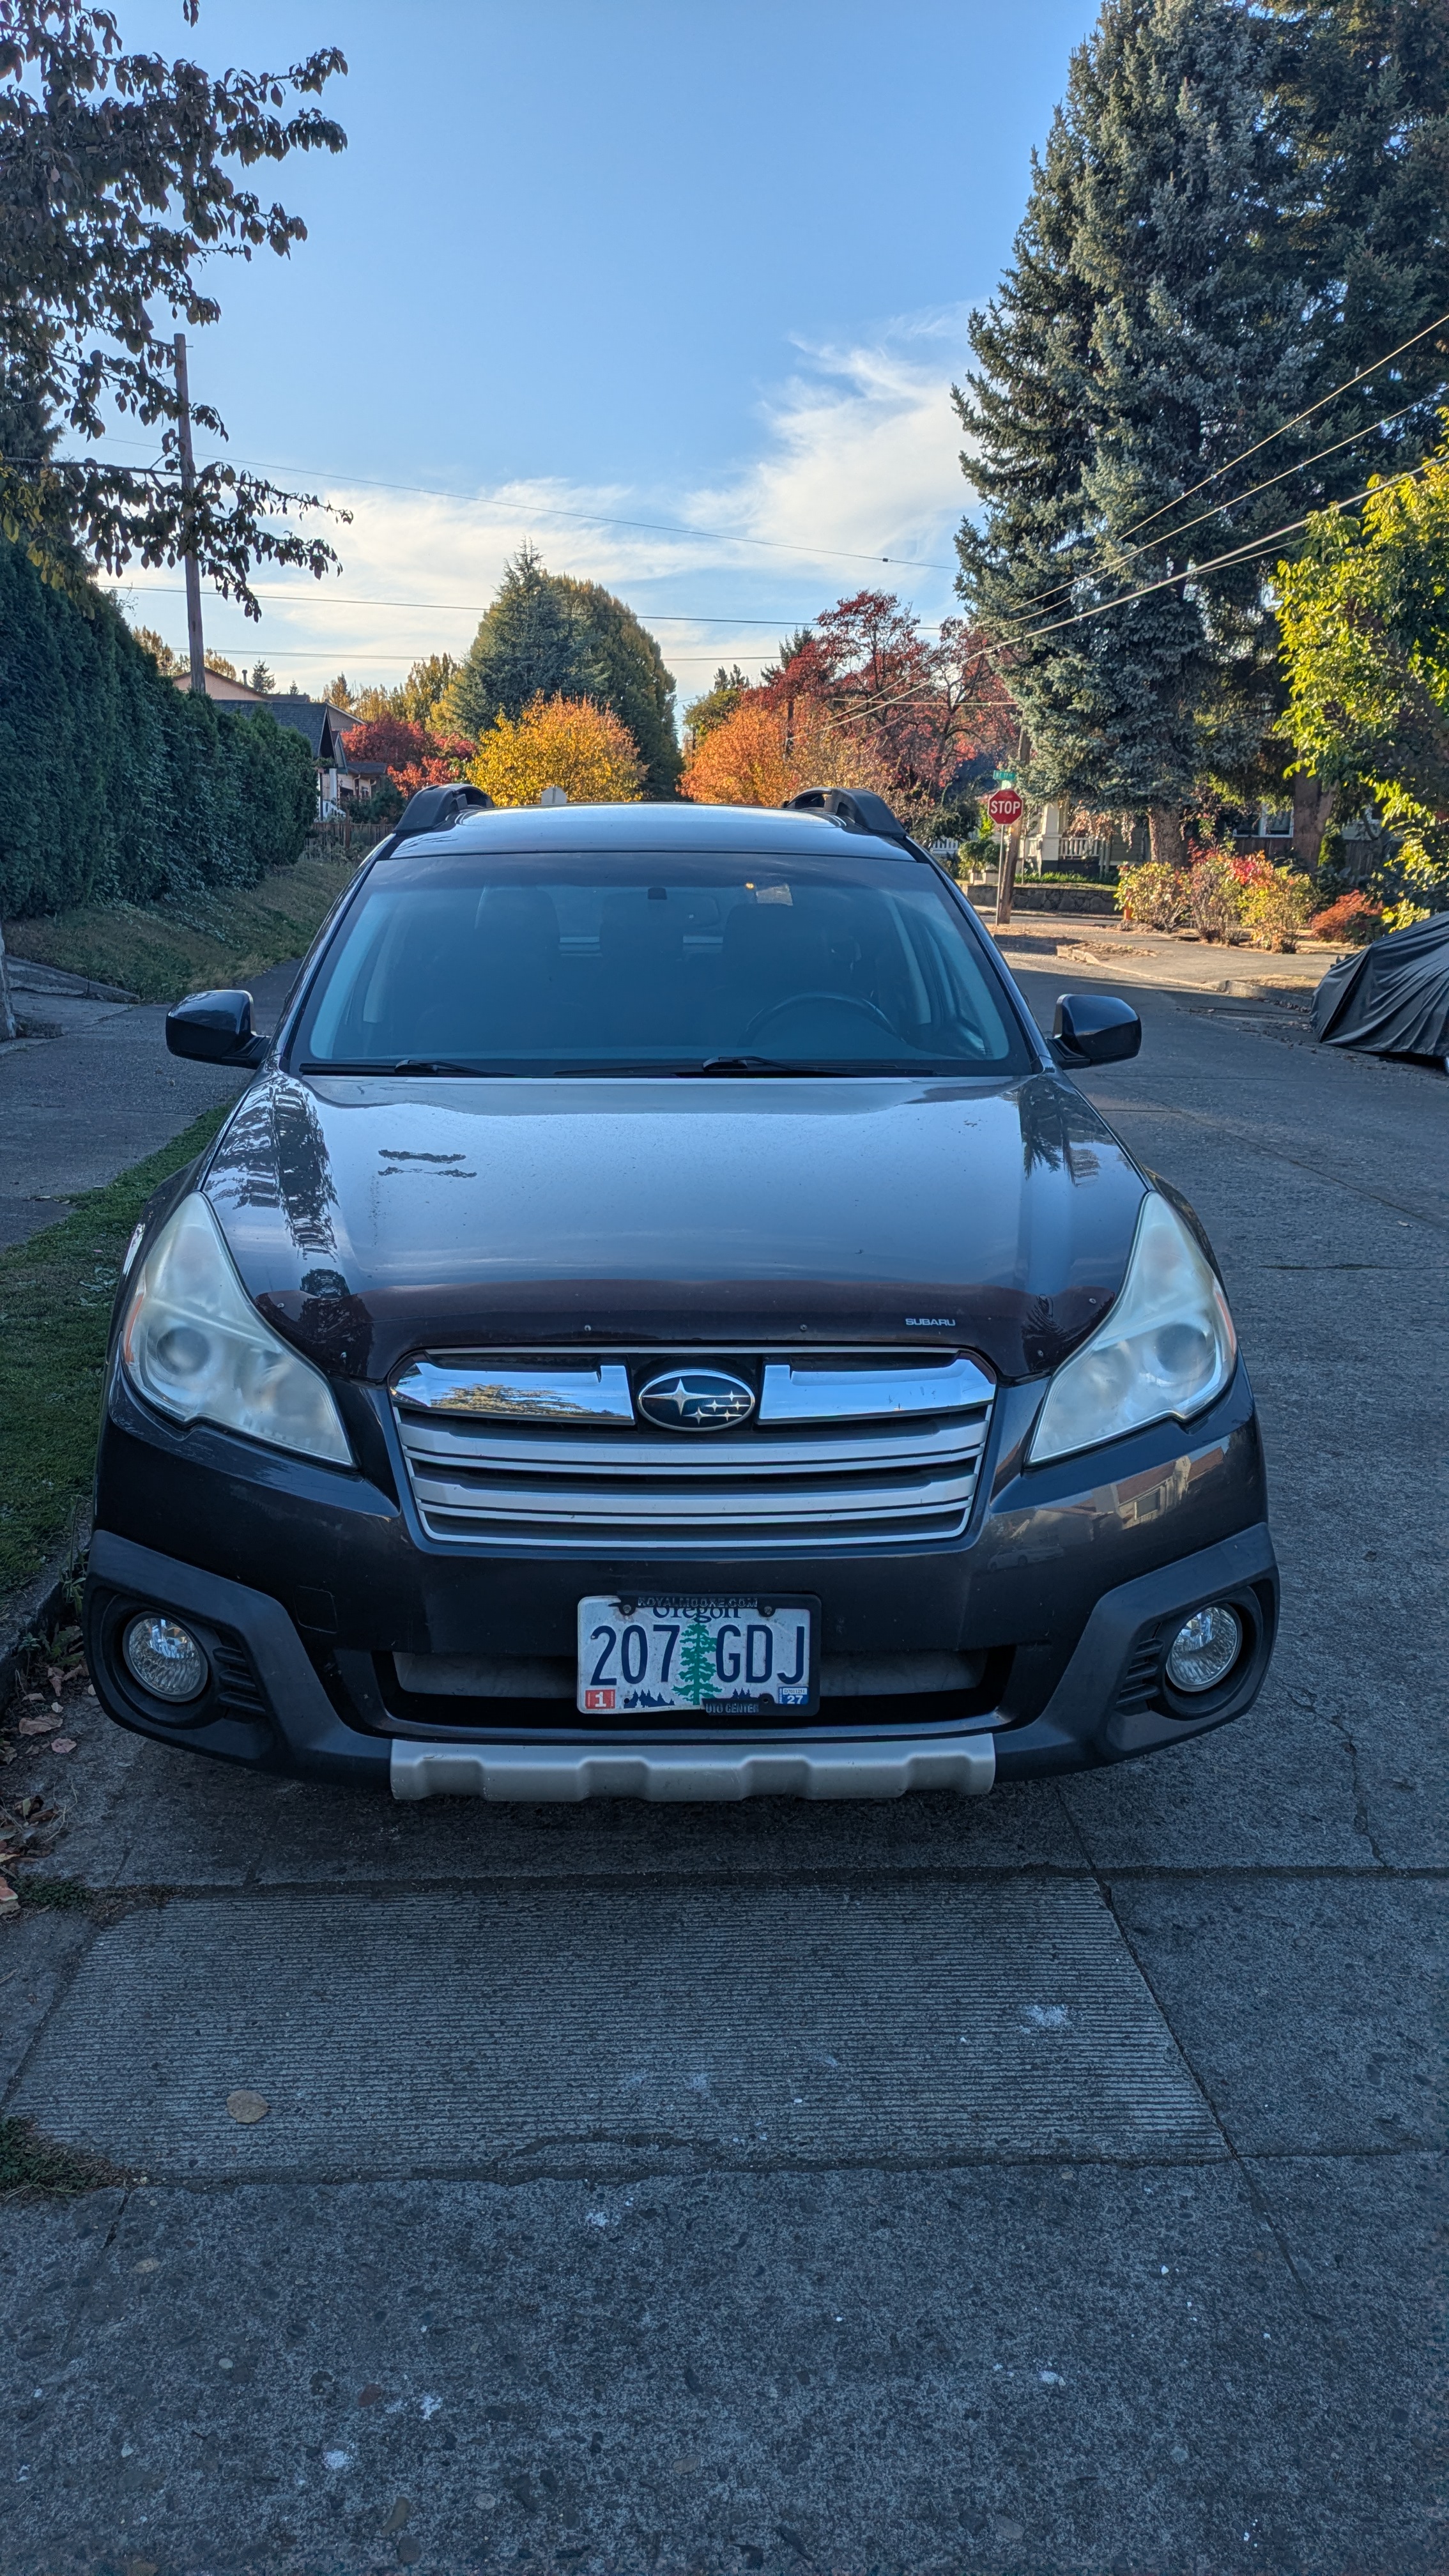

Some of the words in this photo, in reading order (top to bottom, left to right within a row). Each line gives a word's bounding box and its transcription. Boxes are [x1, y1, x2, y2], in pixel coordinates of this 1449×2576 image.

[990, 800, 1021, 815] STOP
[905, 1318, 956, 1326] SUBARU
[653, 1607, 742, 1623] Oregon
[590, 1625, 680, 1686] 207
[715, 1624, 805, 1685] GDJ
[595, 1691, 607, 1707] 1
[786, 1695, 804, 1704] 27
[724, 1703, 760, 1713] CENTER
